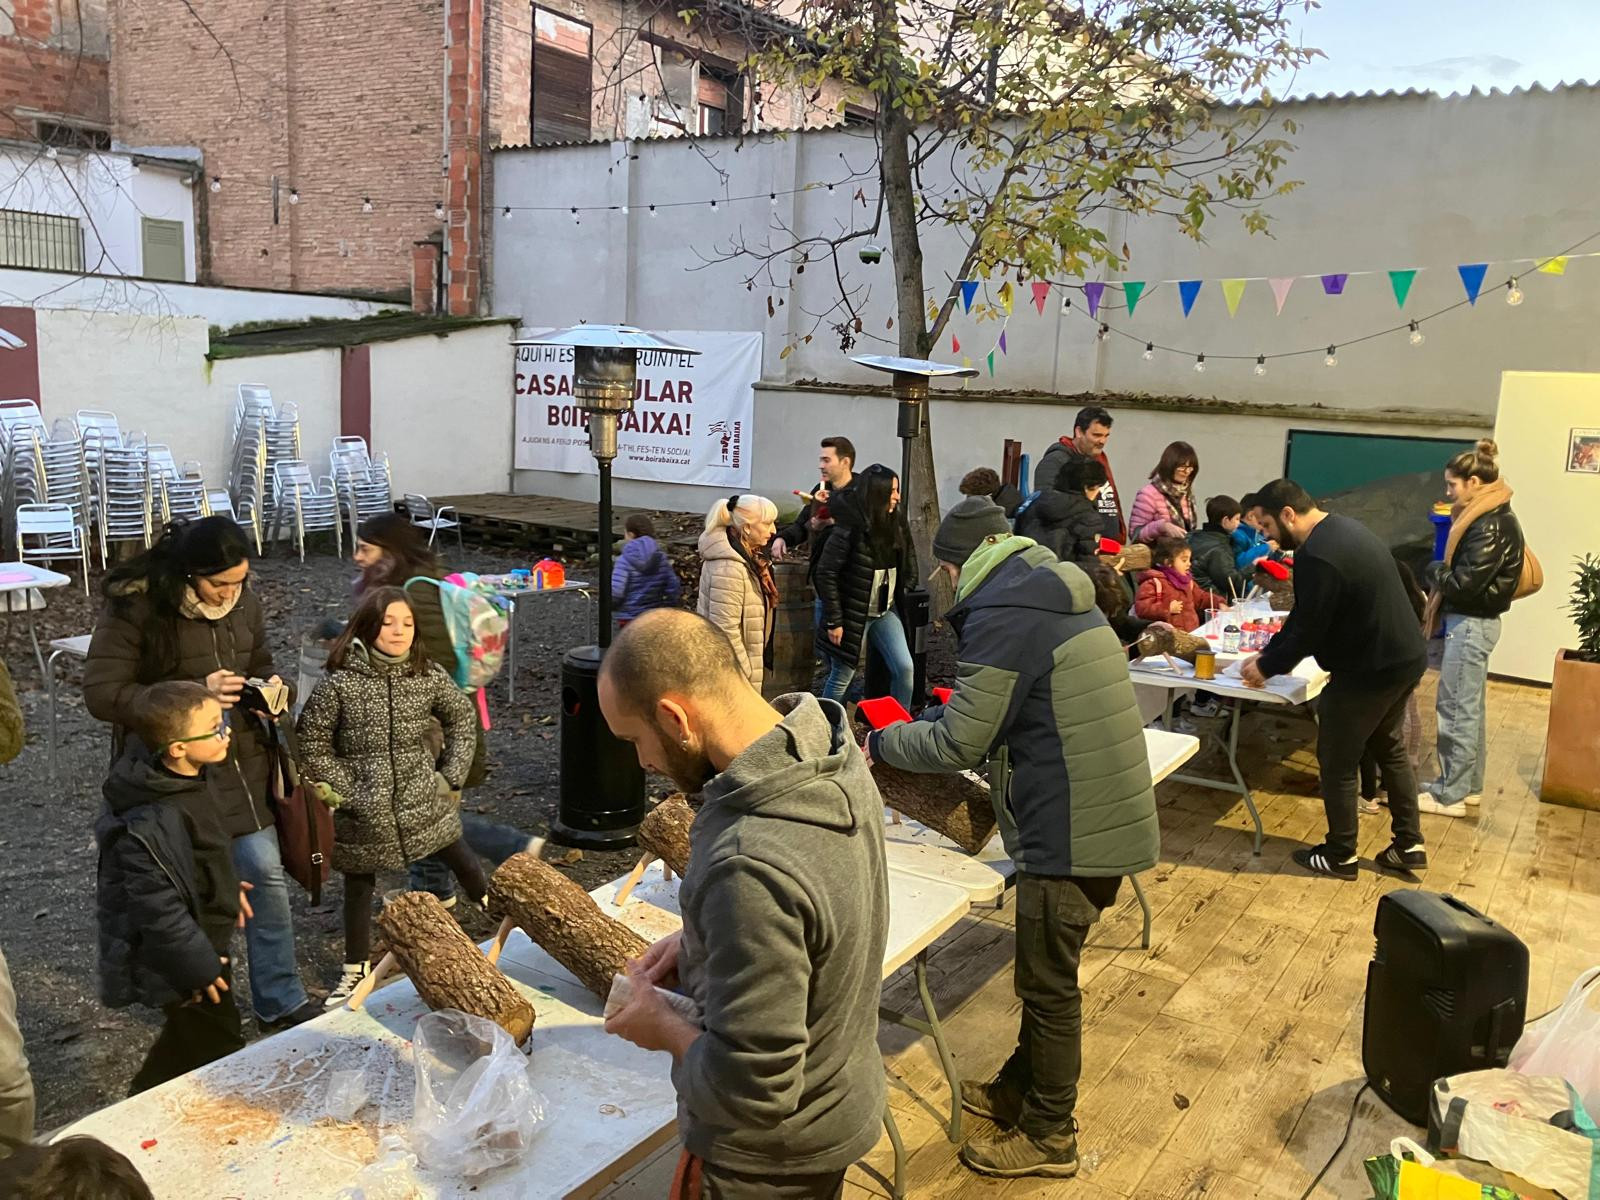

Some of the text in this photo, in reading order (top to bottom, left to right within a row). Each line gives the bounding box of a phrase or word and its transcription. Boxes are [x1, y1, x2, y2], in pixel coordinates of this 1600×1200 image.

[545, 347, 556, 362] HI
[679, 353, 695, 368] EL
[515, 373, 693, 404] CASA ULAR
[547, 405, 691, 436] BOIR BAIXA!
[629, 455, 691, 465] www.boirabaixa.cat
[732, 421, 741, 468] BOIRA BAIXA
